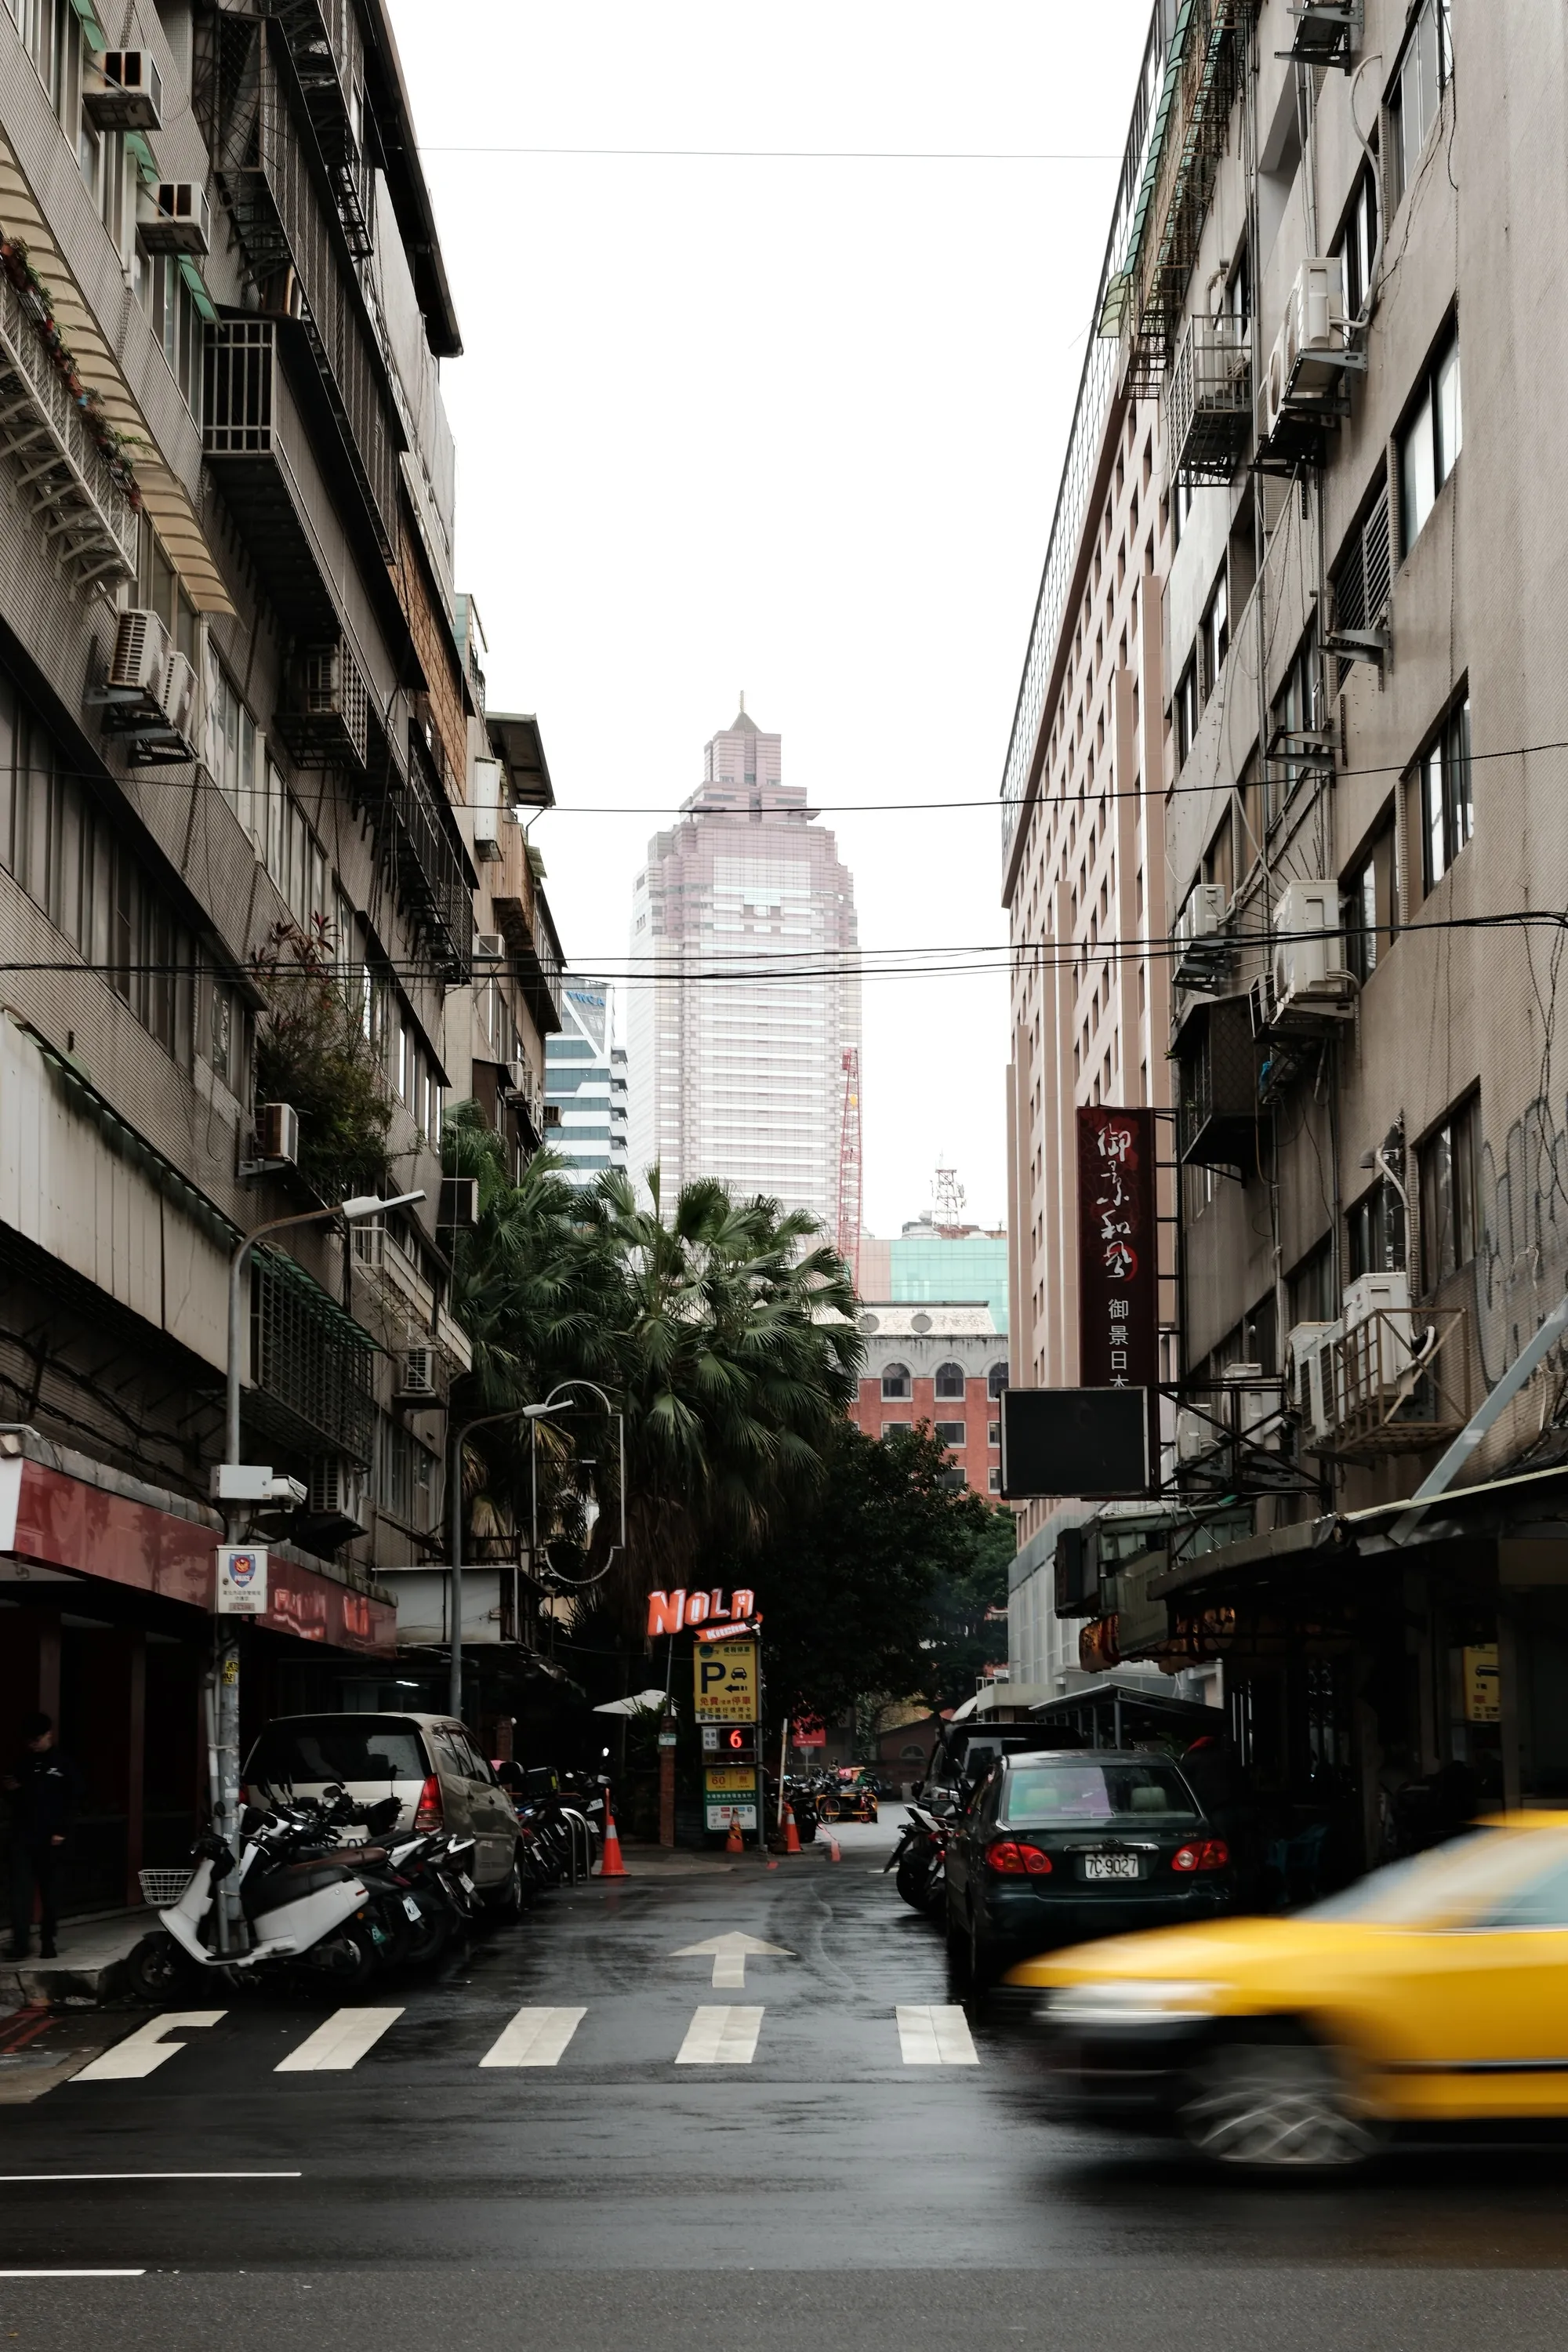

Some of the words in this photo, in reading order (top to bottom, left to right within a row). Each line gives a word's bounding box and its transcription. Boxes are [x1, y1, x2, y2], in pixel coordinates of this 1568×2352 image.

[567, 990, 604, 1007] YWCA
[648, 1588, 754, 1636] NOLA
[701, 1662, 726, 1693] P
[730, 1730, 742, 1748] 6
[711, 1776, 725, 1785] 60
